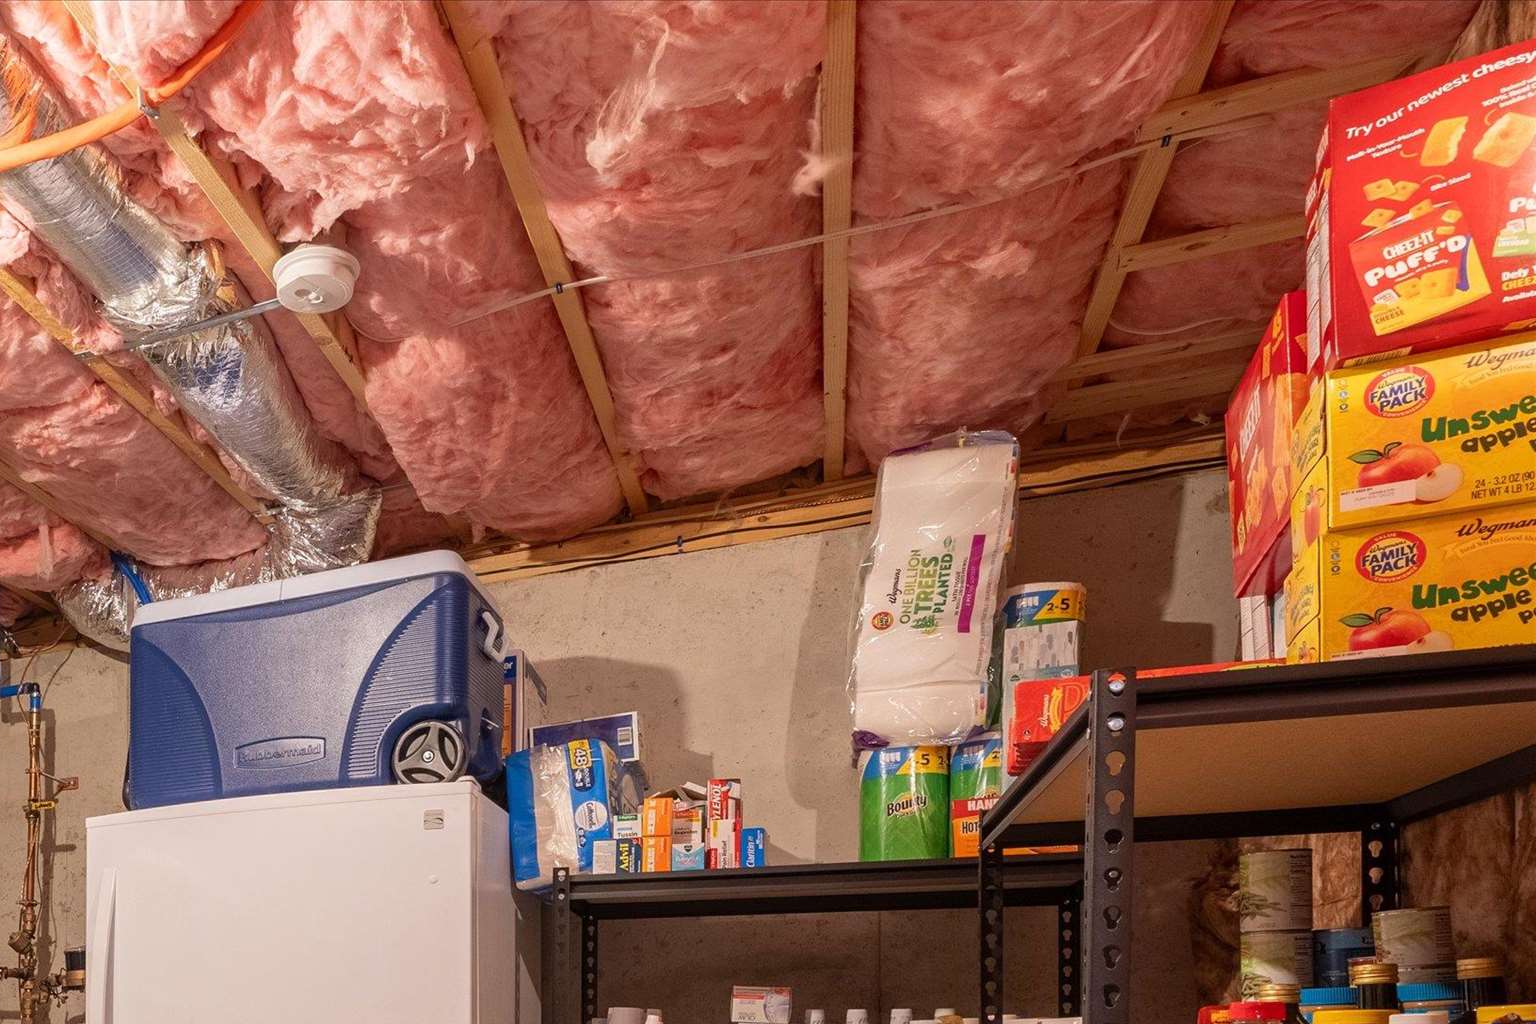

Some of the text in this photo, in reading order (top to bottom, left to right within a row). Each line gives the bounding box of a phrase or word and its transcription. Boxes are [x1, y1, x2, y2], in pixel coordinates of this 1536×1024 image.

[1346, 50, 1536, 139] Try our newest cheesy
[1383, 230, 1434, 260] CHEEZ-IT
[1369, 376, 1425, 403] FAMILY
[1379, 389, 1426, 412] PACK
[1471, 489, 1488, 500] NET
[1489, 487, 1502, 498] WT
[1504, 486, 1509, 495] 4
[1511, 484, 1522, 493] LB
[1475, 479, 1485, 488] 24
[1494, 475, 1506, 487] 3.2
[1508, 474, 1520, 484] OZ
[1362, 543, 1417, 568] FAMILY
[1371, 555, 1417, 576] PACK
[887, 568, 902, 604] Wegmans
[900, 549, 921, 624] ONE BILLION
[914, 556, 939, 615] TREES
[932, 553, 953, 614] PLANTED
[1451, 589, 1532, 623] apple
[575, 748, 588, 767] 48
[712, 783, 721, 820] YLENOL
[620, 843, 629, 871] Advil
